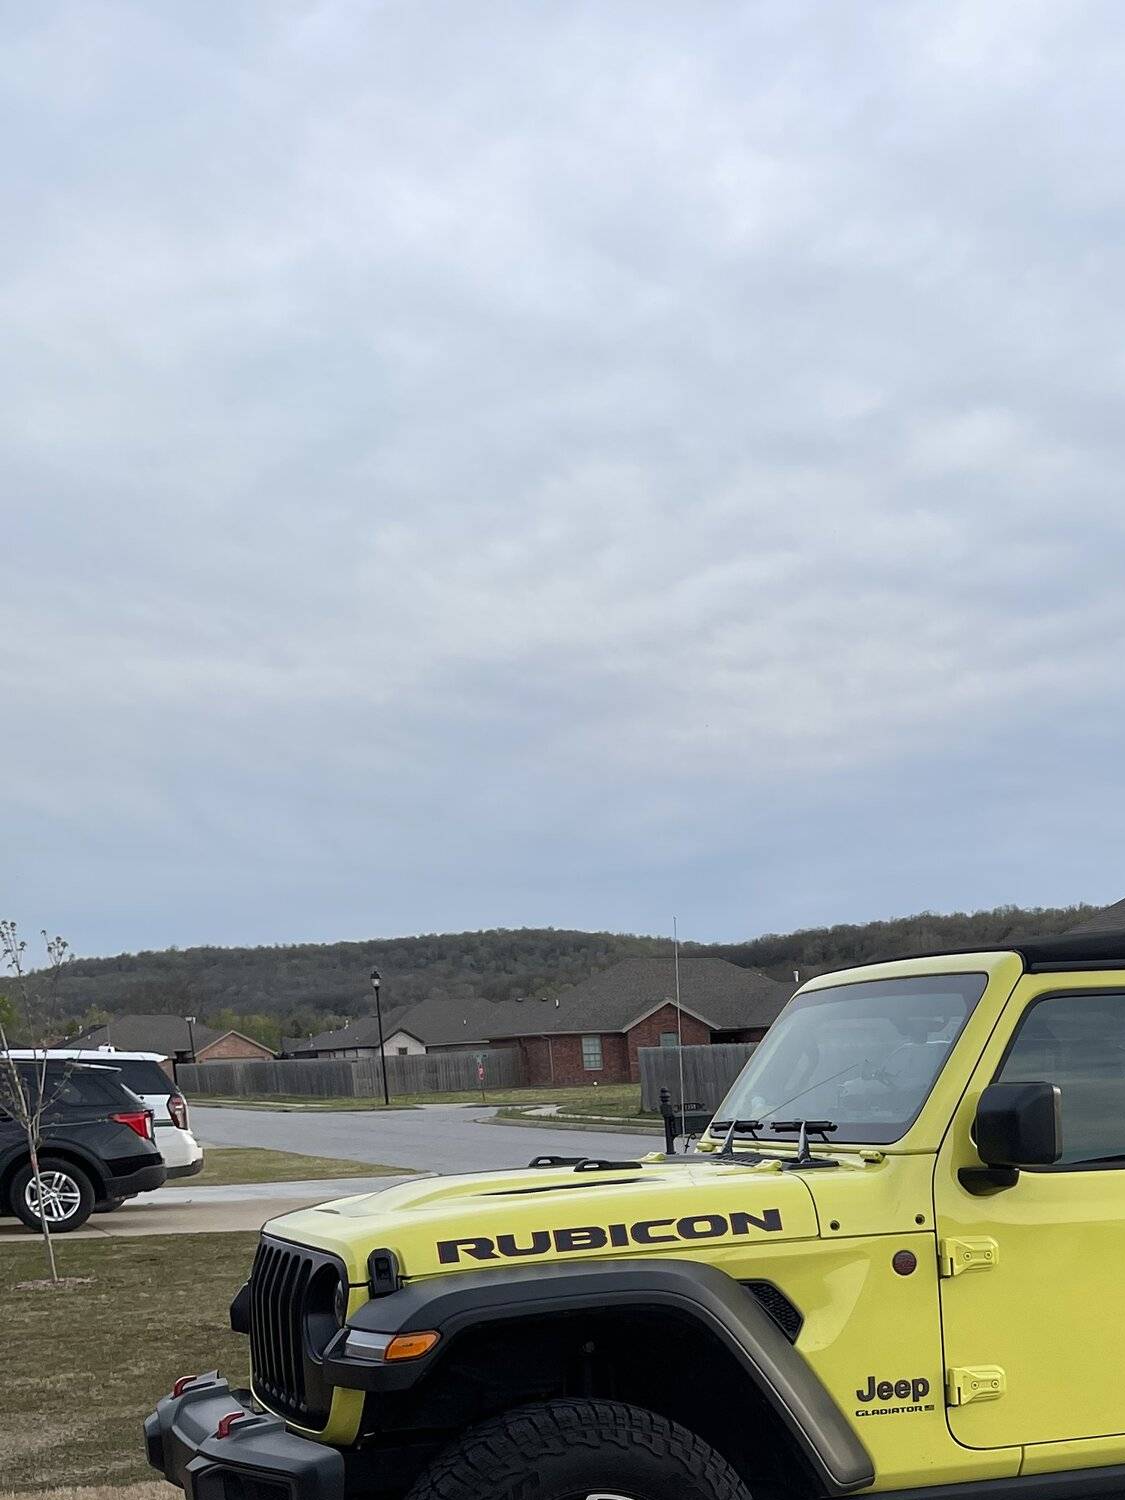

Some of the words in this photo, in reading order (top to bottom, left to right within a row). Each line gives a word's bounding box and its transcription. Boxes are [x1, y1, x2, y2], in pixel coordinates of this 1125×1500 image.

[436, 1208, 783, 1264] RUBICON
[855, 1376, 930, 1402] Jeep
[855, 1405, 923, 1417] GLADIATOR
